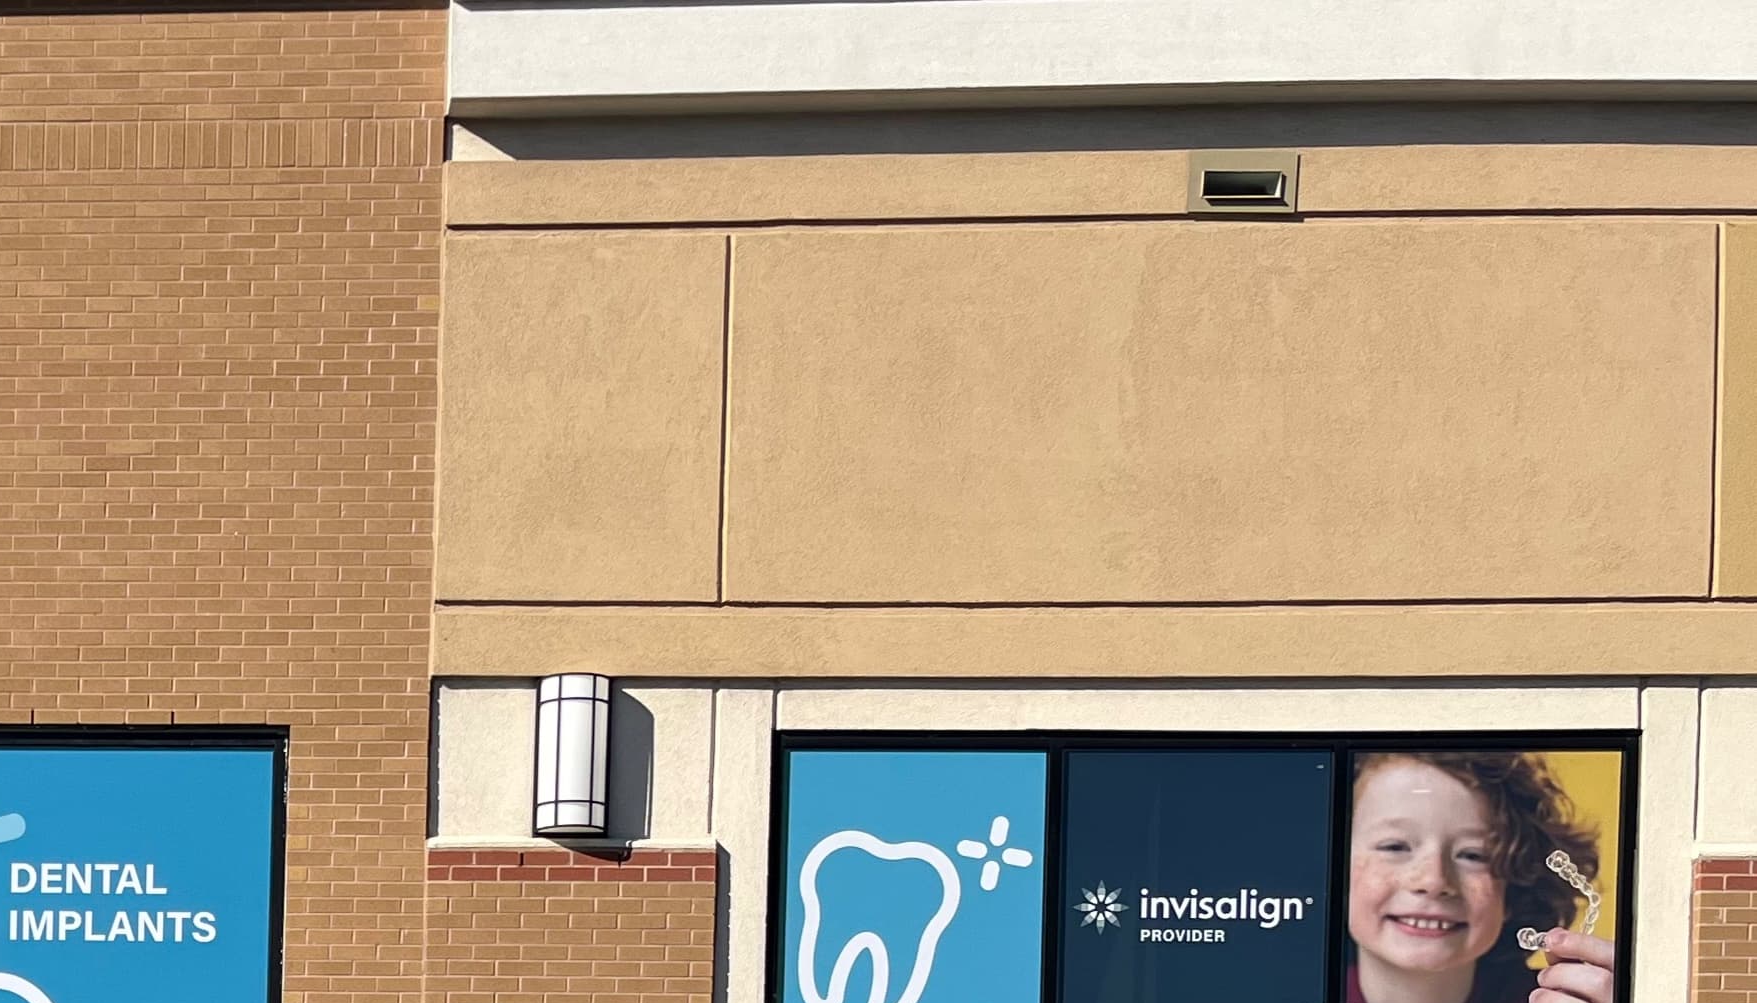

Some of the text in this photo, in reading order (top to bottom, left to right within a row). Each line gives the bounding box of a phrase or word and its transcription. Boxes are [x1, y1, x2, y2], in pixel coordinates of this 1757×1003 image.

[10, 862, 168, 895] DENTAL
[9, 909, 217, 943] IMPLANTS
[1139, 929, 1226, 942] PROVIDER
